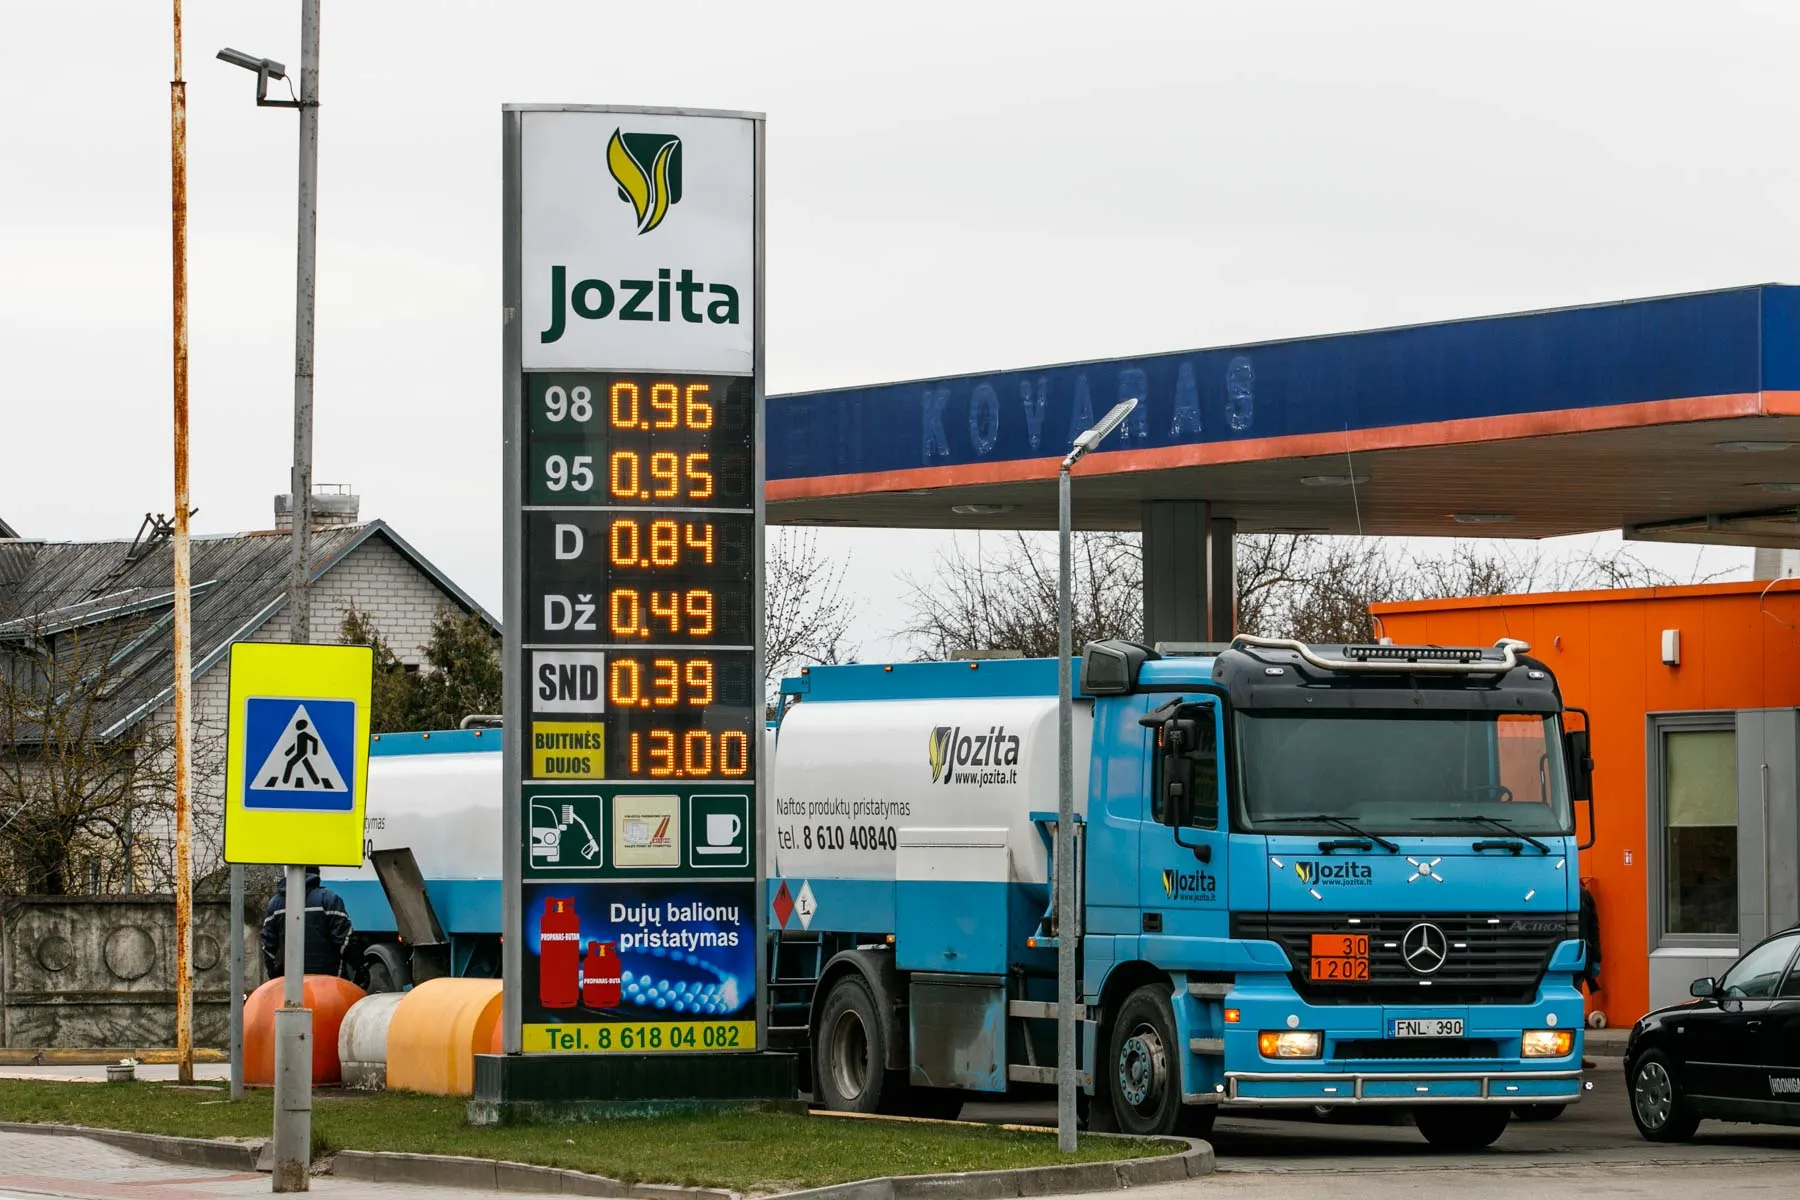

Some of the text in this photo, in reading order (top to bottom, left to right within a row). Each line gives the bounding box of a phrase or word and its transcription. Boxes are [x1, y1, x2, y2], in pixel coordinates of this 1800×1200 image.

[540, 265, 740, 344] Jozita
[545, 383, 713, 430] 98 0.96
[545, 451, 713, 499] 95 0.95
[555, 520, 713, 567] D 0.84
[544, 589, 713, 636] Dž 0.49
[538, 659, 713, 706] SND 0.39
[535, 730, 601, 750] BUITINĖS
[545, 756, 591, 774] DUJOS
[631, 730, 748, 776] 13.00
[944, 726, 1020, 785] Jozita
[955, 769, 1017, 788] www.jozita.lt
[776, 797, 911, 820] Naftos produktų pristatymas
[778, 825, 898, 851] tel. 8 610 40840
[1174, 869, 1216, 901] Jozita
[1313, 862, 1372, 885] Jozita
[610, 902, 740, 927] Dujų balionų
[620, 928, 739, 953] pristatymas
[1343, 938, 1367, 956] 30
[1315, 960, 1367, 979] 1202
[546, 1025, 740, 1050] Tel. 8 618 04 082
[1436, 1020, 1462, 1035] 390
